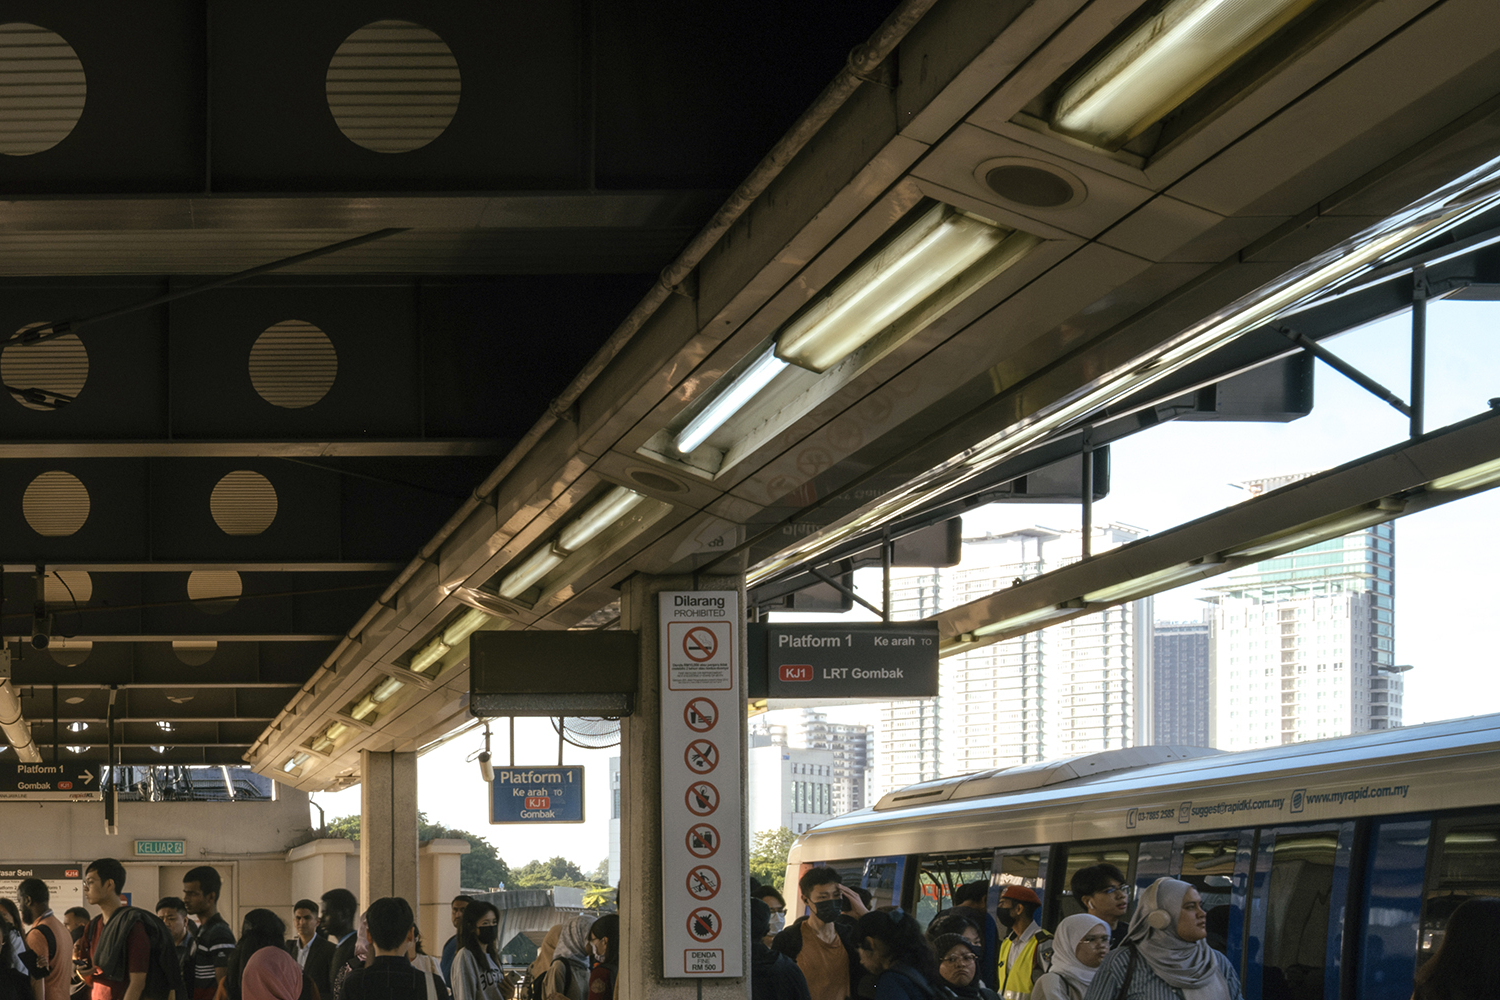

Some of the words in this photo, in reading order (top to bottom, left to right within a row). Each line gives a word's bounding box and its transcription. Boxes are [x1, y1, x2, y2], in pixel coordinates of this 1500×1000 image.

[674, 595, 725, 609] Dilarang
[674, 609, 726, 618] PROHIBITED
[778, 634, 841, 648] Platform
[845, 634, 852, 647] 1
[874, 637, 889, 646] Ke
[891, 636, 915, 646] arah
[921, 638, 932, 646] TO
[785, 668, 806, 679] KJ1
[822, 668, 848, 679] LRT
[851, 667, 904, 679] Gombak
[17, 764, 57, 774] Platform
[59, 765, 64, 774] 1
[500, 770, 561, 784] Platform
[566, 770, 573, 783] 1
[17, 781, 51, 790] Gombak
[513, 788, 525, 797] Ke
[527, 788, 548, 797] arah
[1306, 784, 1410, 805] www.myrapid.com.my
[529, 799, 547, 808] KJ1
[1191, 798, 1285, 818] suggest@rapidkl.com.my
[520, 809, 556, 819] Gombak
[139, 843, 173, 853] KELUAR
[17, 869, 33, 877] Seni
